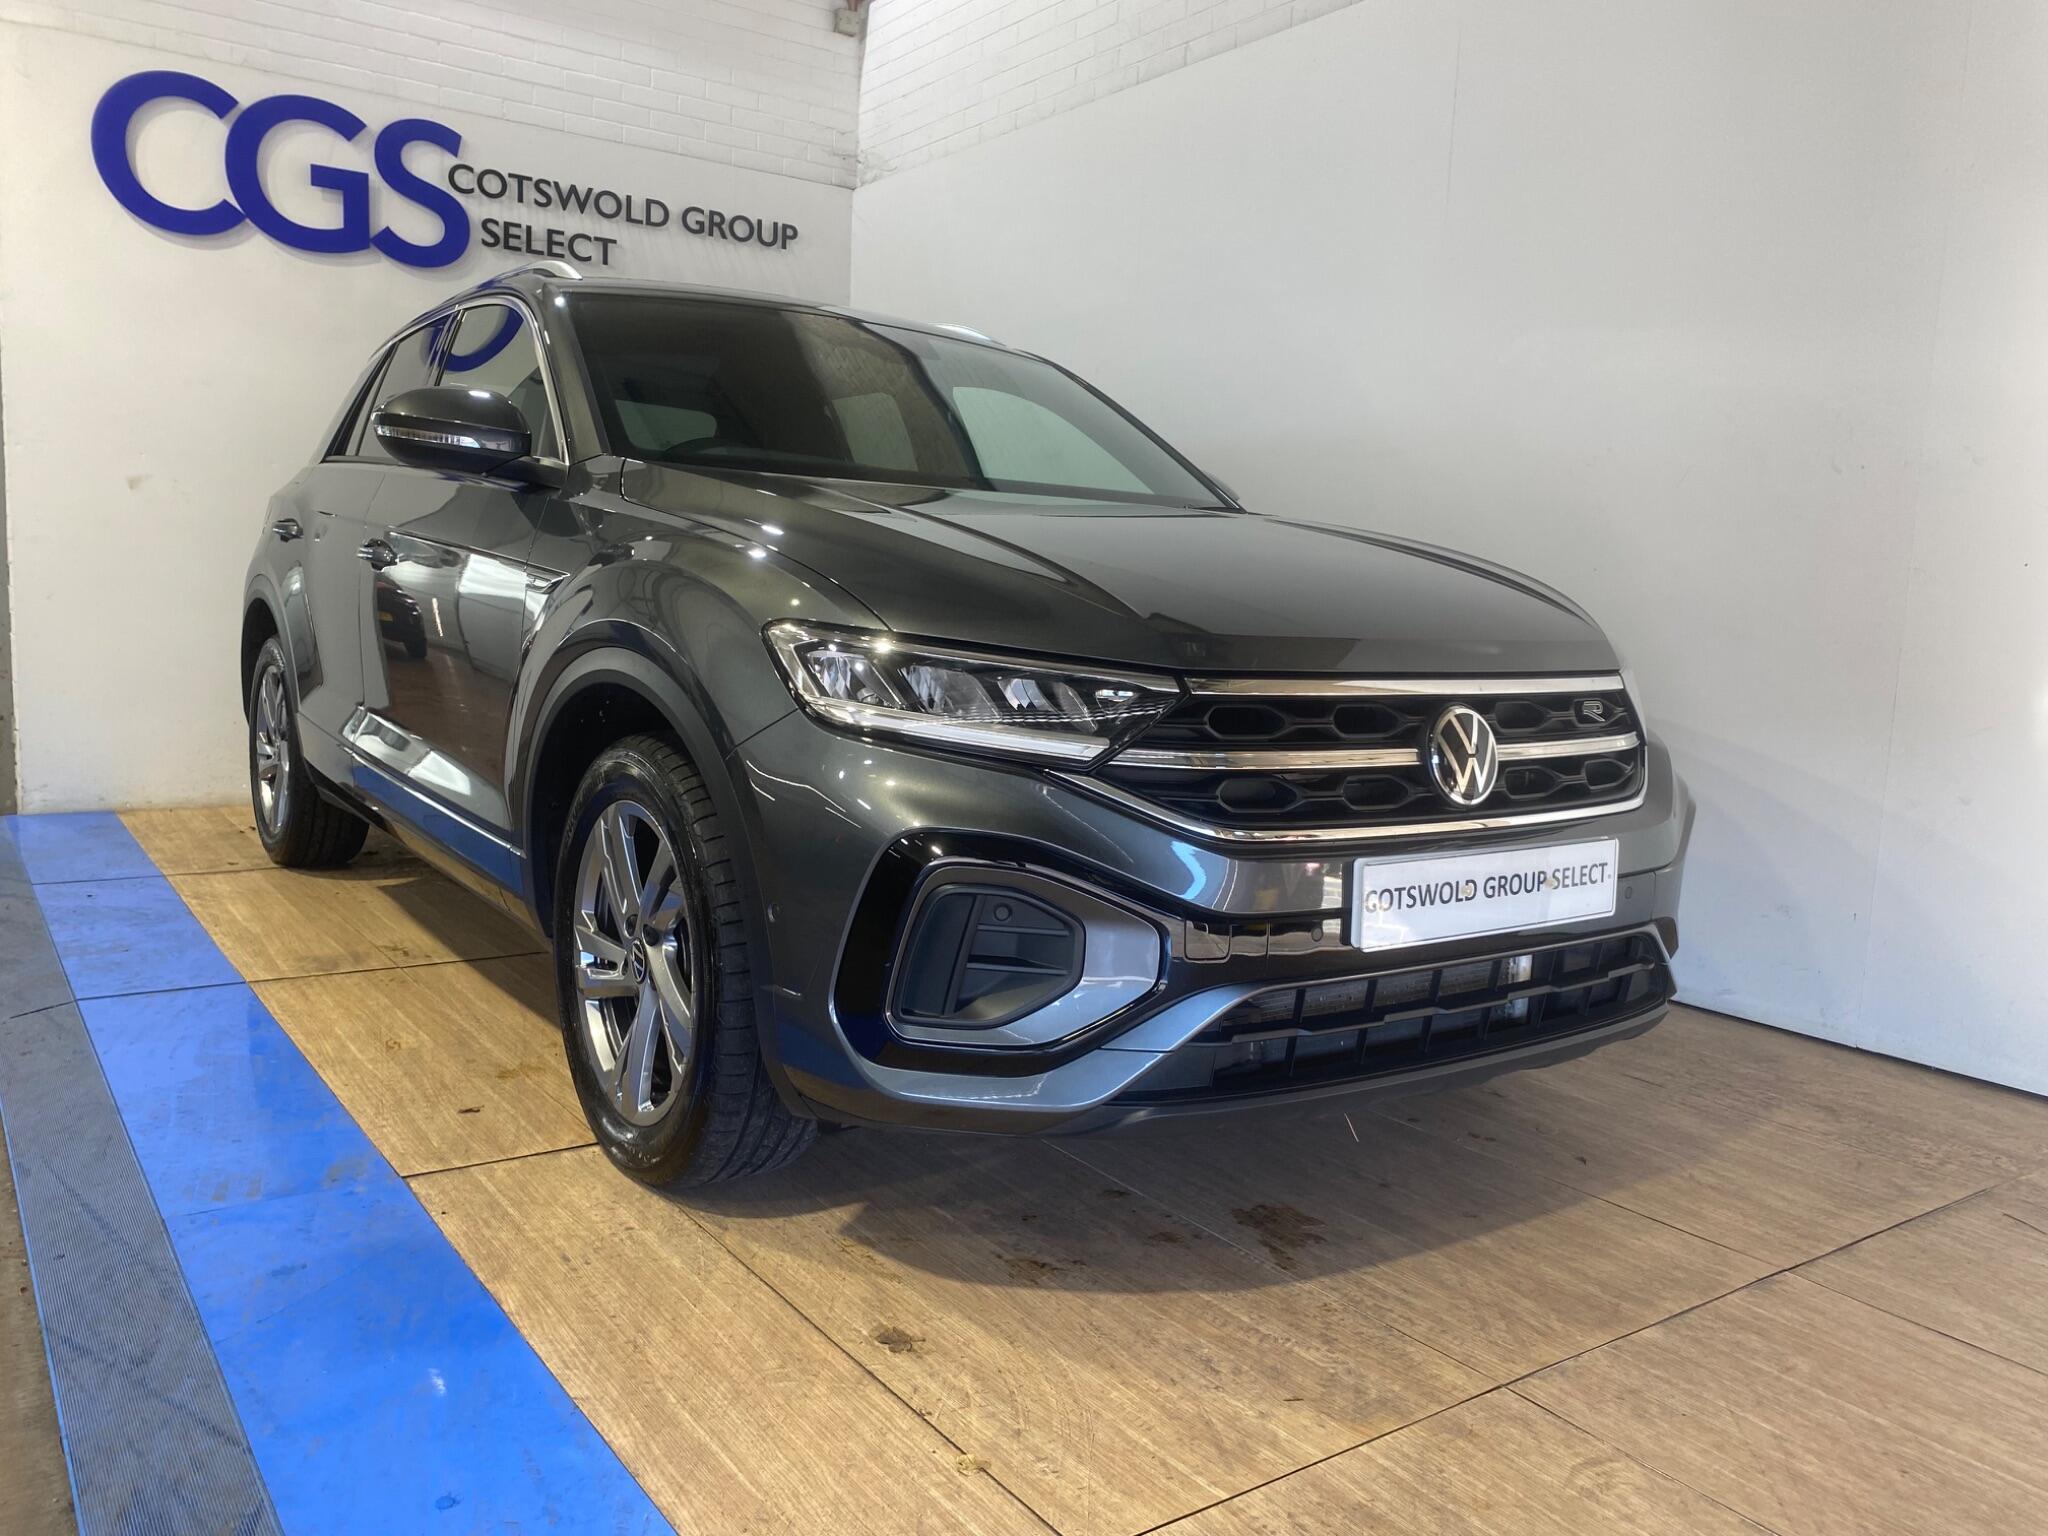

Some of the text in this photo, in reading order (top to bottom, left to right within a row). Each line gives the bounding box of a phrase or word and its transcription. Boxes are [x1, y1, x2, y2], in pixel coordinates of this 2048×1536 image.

[91, 70, 471, 269] CGS
[448, 163, 799, 250] COTSWOLD GROUP
[481, 217, 618, 267] SELECT
[1483, 870, 1547, 899] GROUP
[1551, 862, 1608, 890] SELECT
